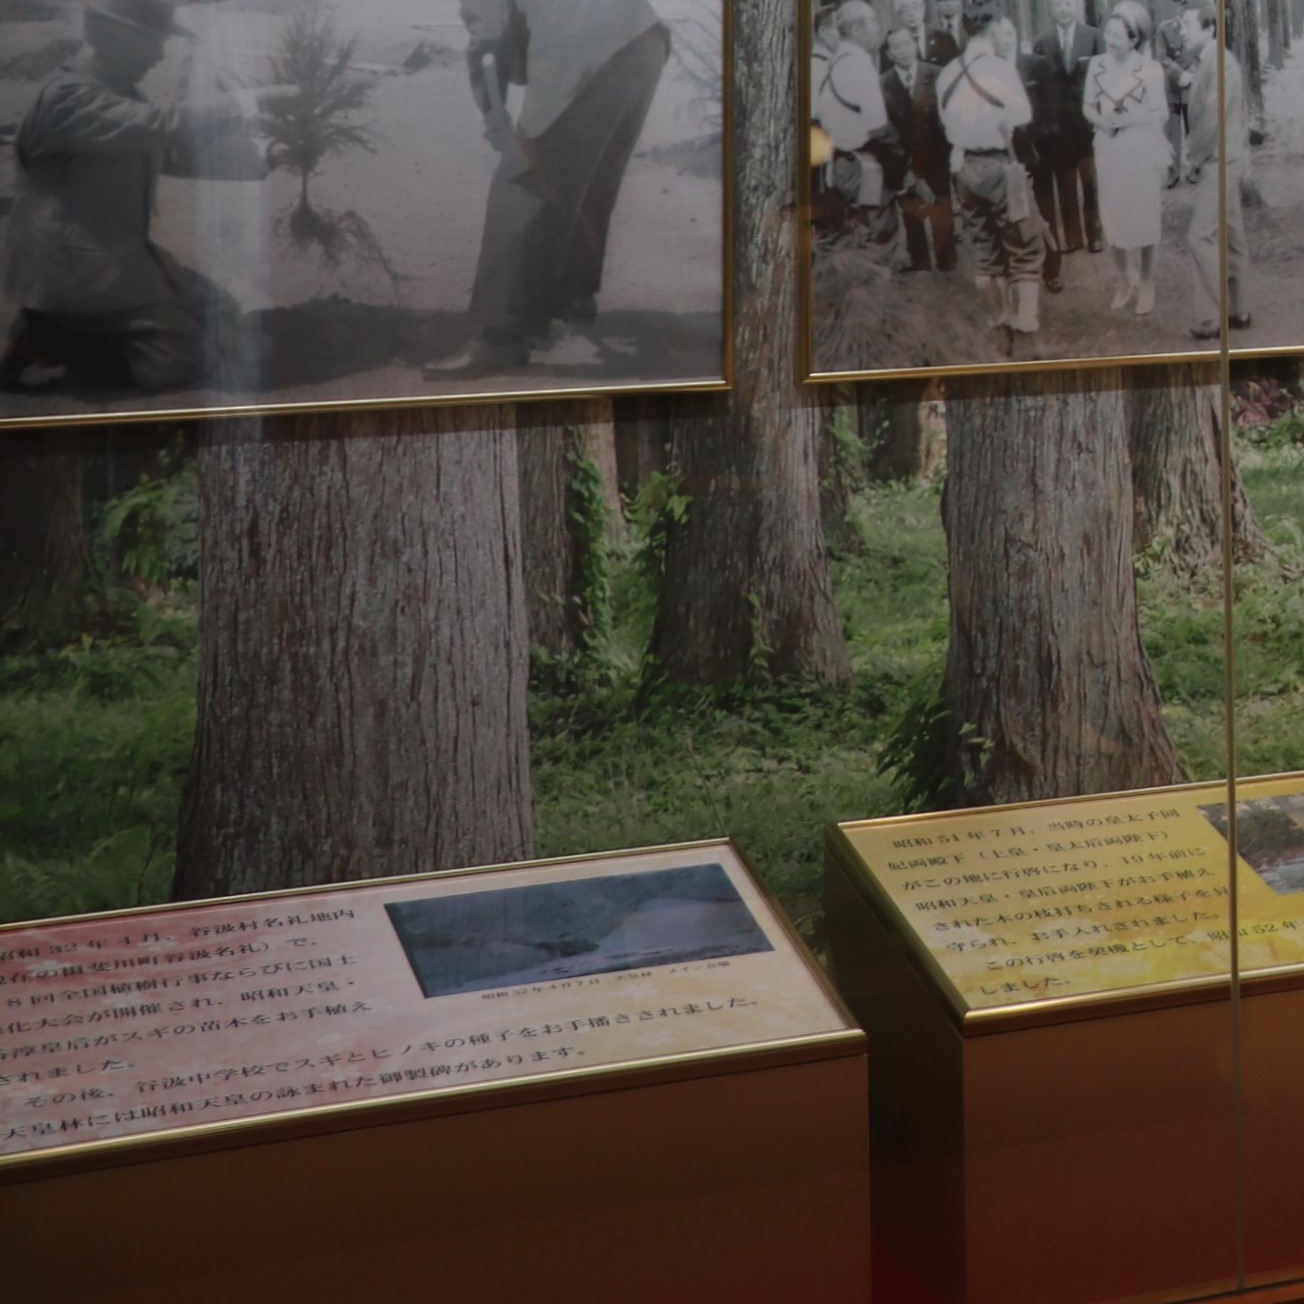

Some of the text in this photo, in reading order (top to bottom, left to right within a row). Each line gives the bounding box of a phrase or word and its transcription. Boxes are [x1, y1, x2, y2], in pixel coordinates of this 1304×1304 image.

[0, 937, 318, 986] 在の揖斐川町谷汲名礼）で、
[0, 980, 356, 1036] 化大会が開催され、昭和天皇・
